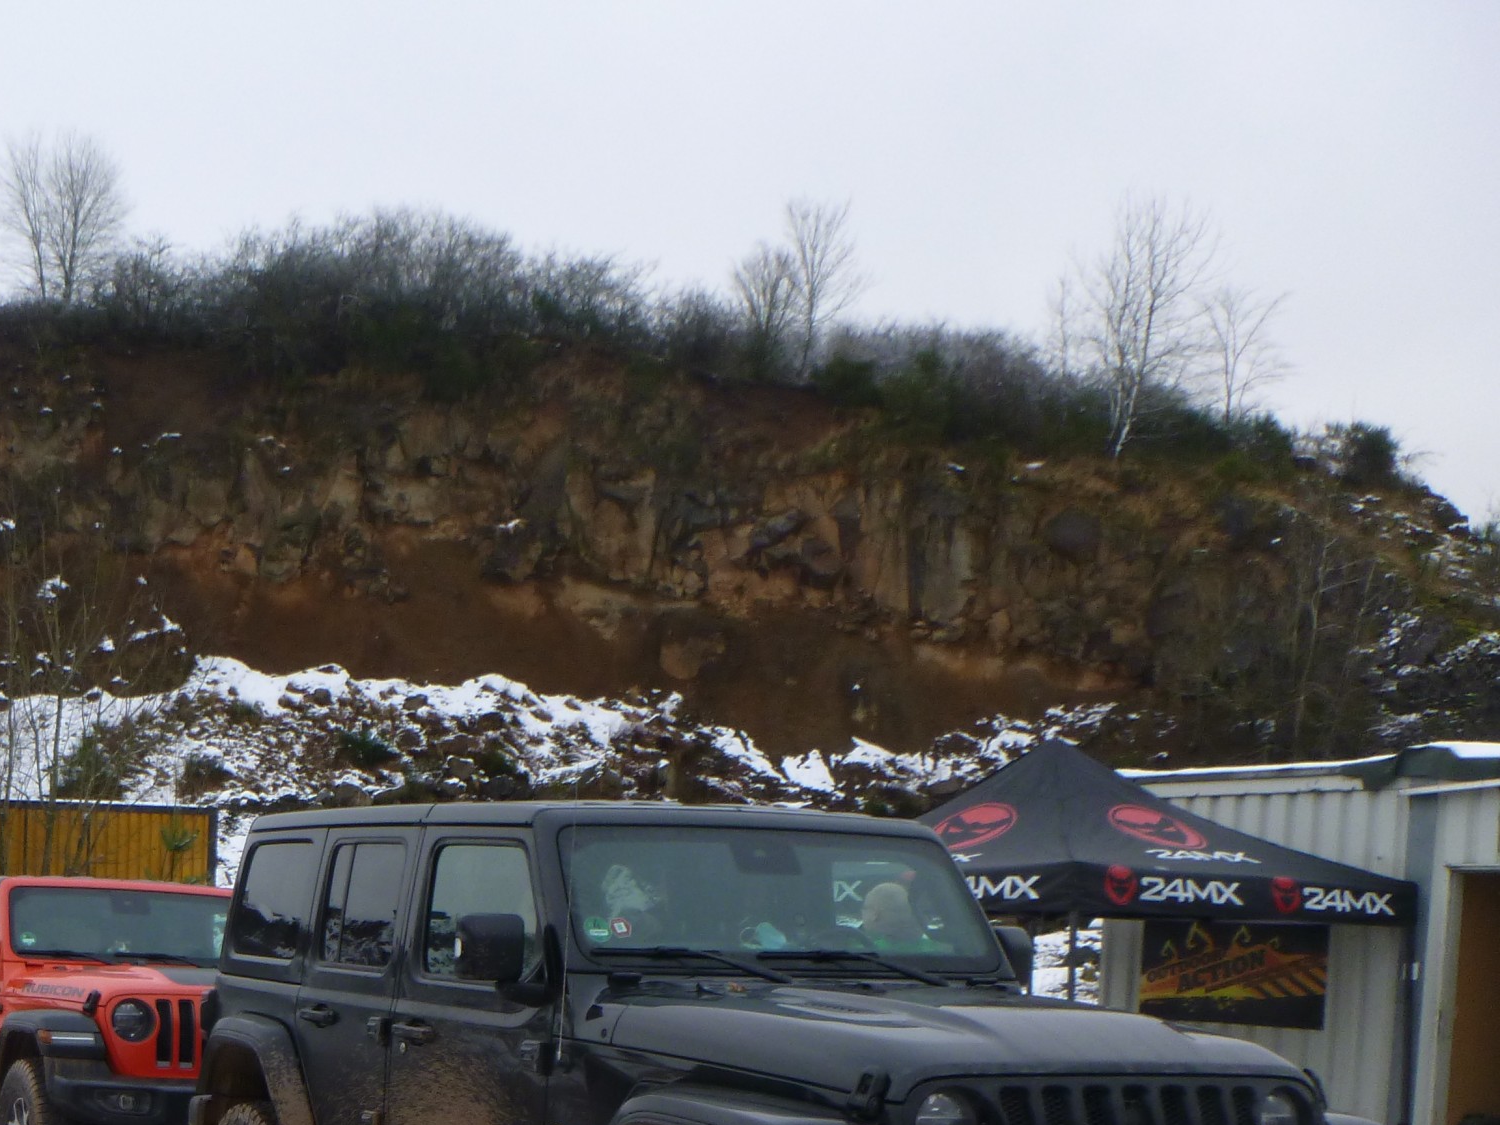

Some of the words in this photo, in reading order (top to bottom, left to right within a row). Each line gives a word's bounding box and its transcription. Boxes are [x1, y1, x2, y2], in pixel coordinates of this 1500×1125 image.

[1145, 849, 1262, 864] 24MX
[1140, 877, 1245, 906] 24MX
[1303, 887, 1395, 916] 24MX
[1177, 951, 1266, 993] ACTION
[22, 982, 85, 998] RUBICON
